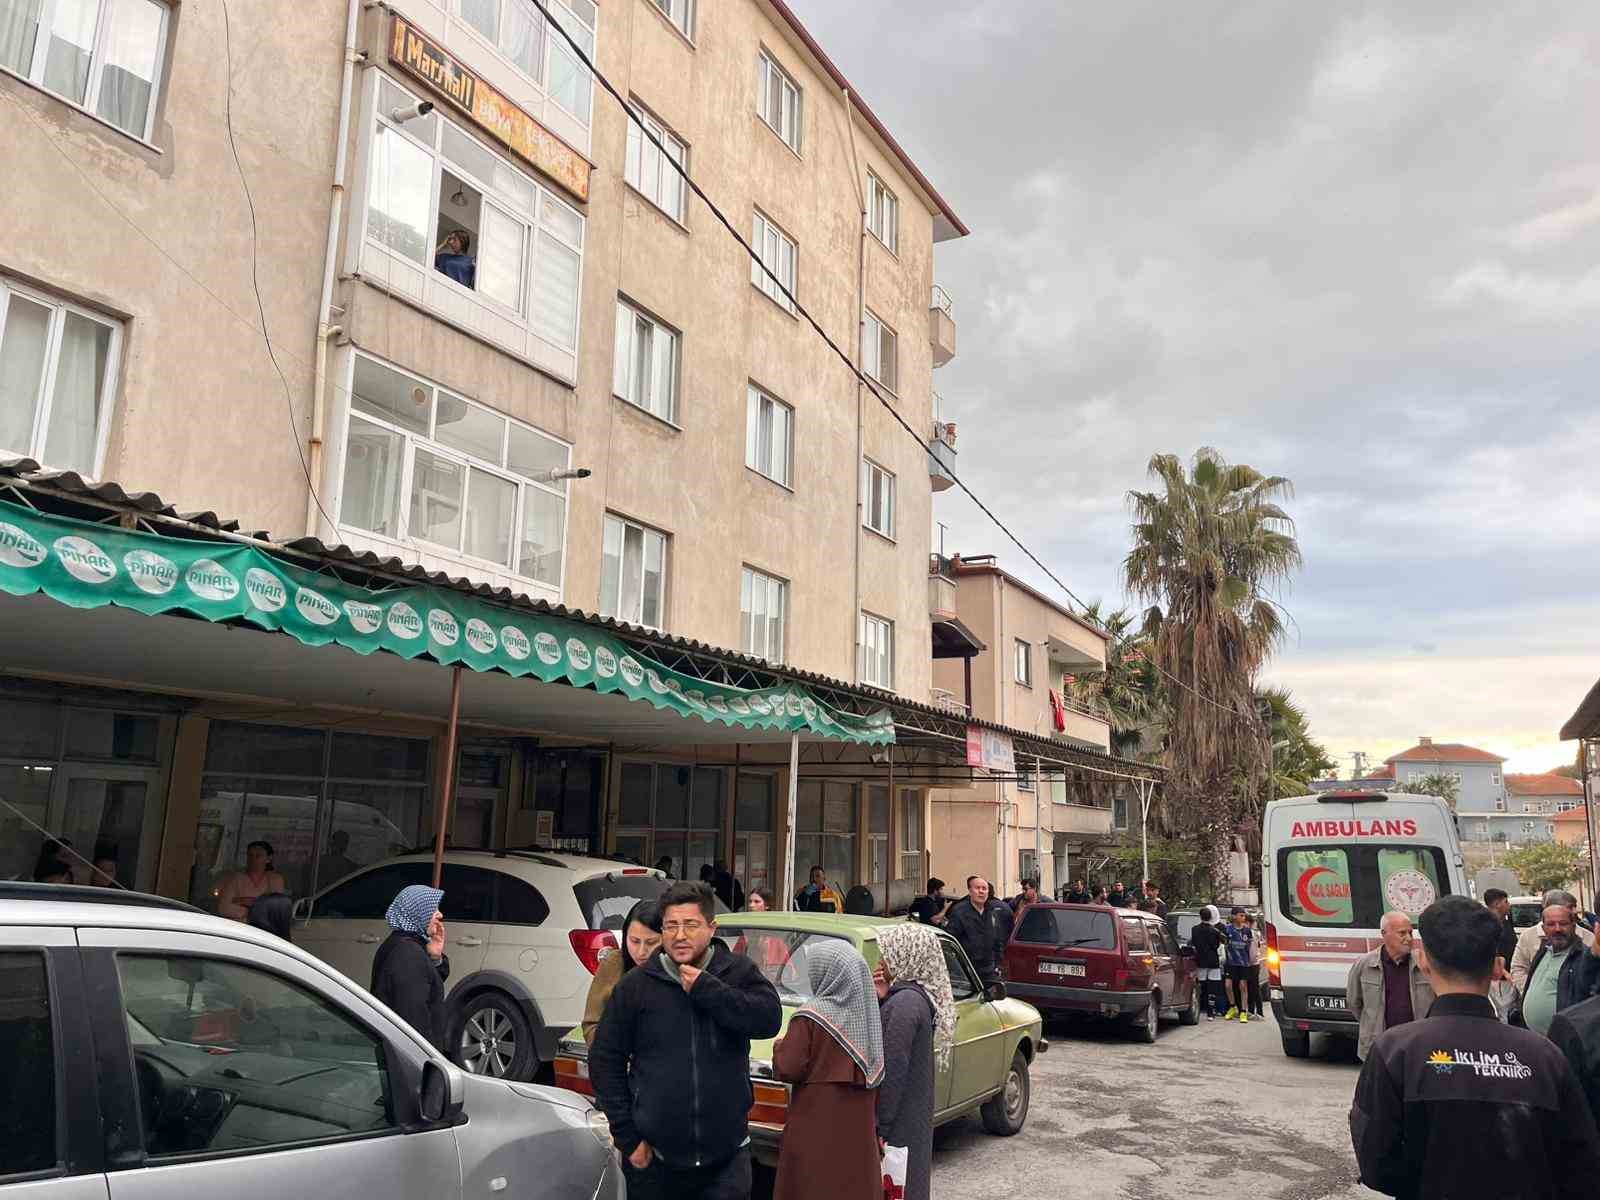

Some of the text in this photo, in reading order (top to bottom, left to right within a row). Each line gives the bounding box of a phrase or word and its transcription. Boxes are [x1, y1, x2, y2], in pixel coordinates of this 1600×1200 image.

[0, 531, 40, 553] INAR
[131, 562, 174, 578] PINAR
[190, 570, 232, 586] PINAR
[247, 579, 281, 598] PINAR
[299, 595, 335, 613] PINAR
[389, 613, 418, 626] PINAR
[1291, 818, 1418, 838] AMBULANS
[1313, 997, 1325, 1007] 48
[1454, 1048, 1500, 1066] İKLİM
